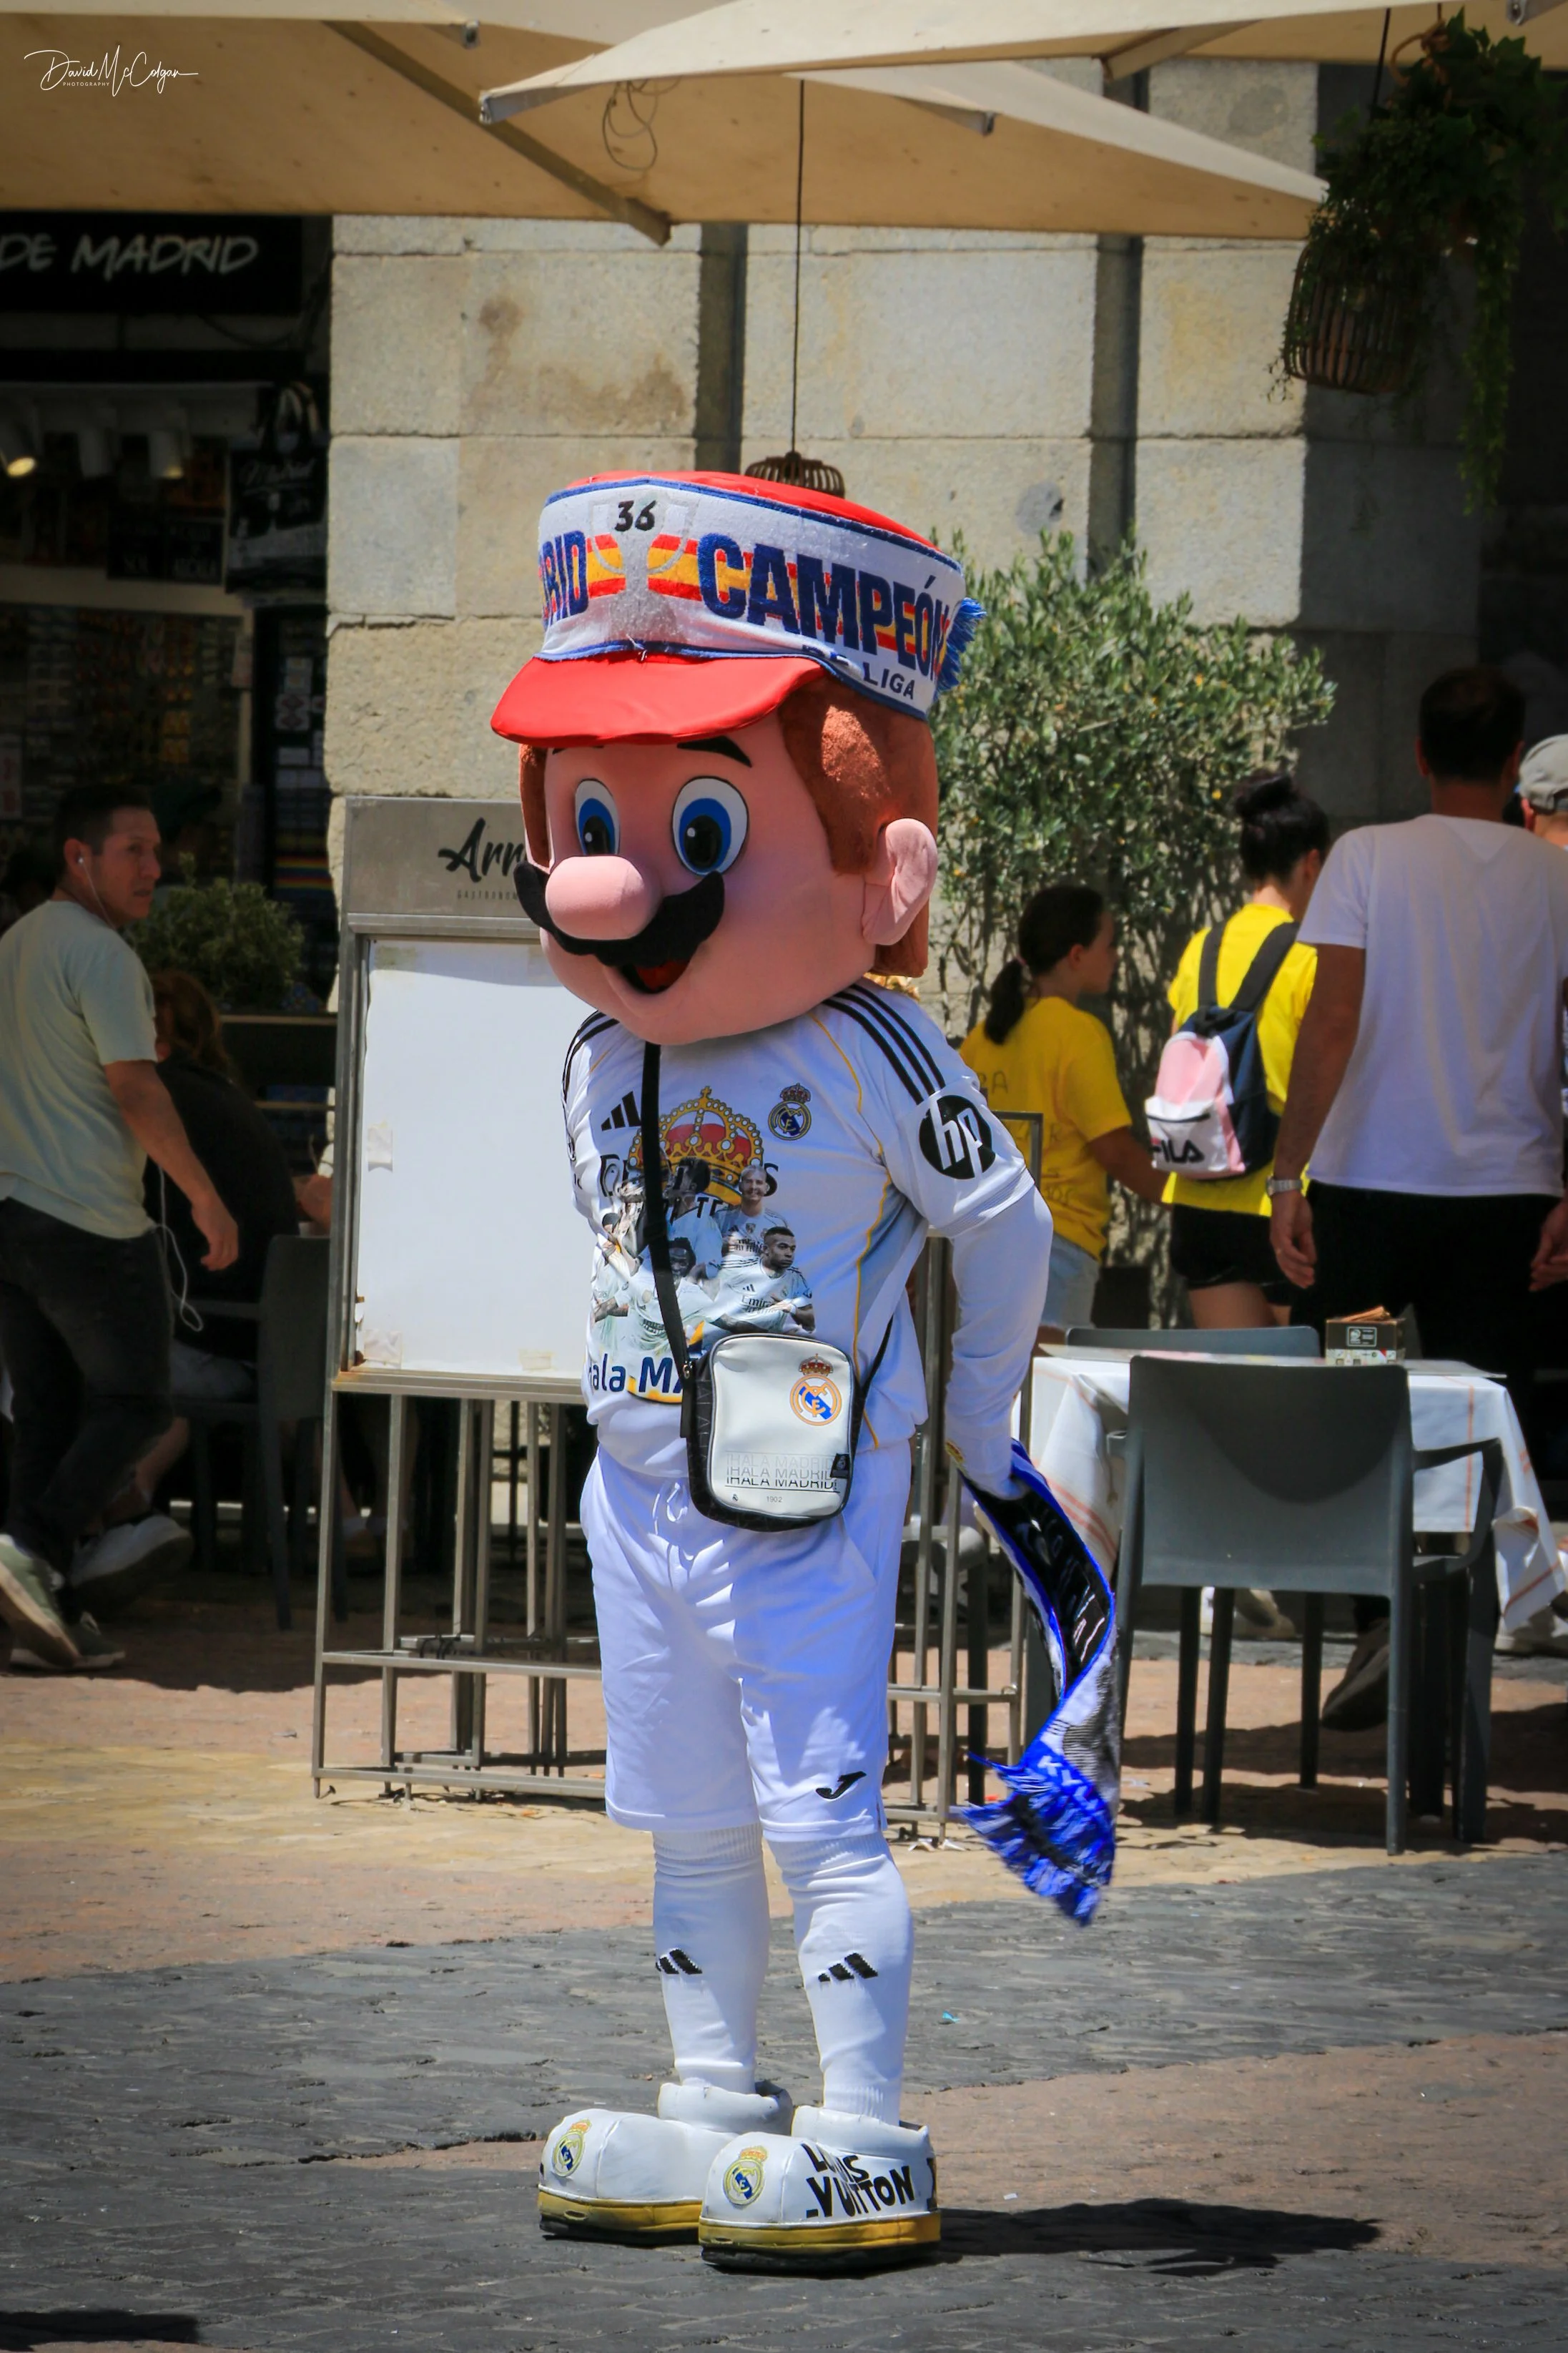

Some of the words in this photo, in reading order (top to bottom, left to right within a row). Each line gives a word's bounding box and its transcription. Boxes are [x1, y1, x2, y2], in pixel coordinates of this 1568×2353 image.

[0, 232, 57, 272] DE
[70, 232, 260, 283] MADRID
[614, 501, 656, 531] 36
[539, 530, 588, 633] RID
[863, 662, 915, 699] LIGA
[438, 817, 528, 883] Arr
[927, 1094, 984, 1179] hp
[1150, 1137, 1205, 1164] FILA
